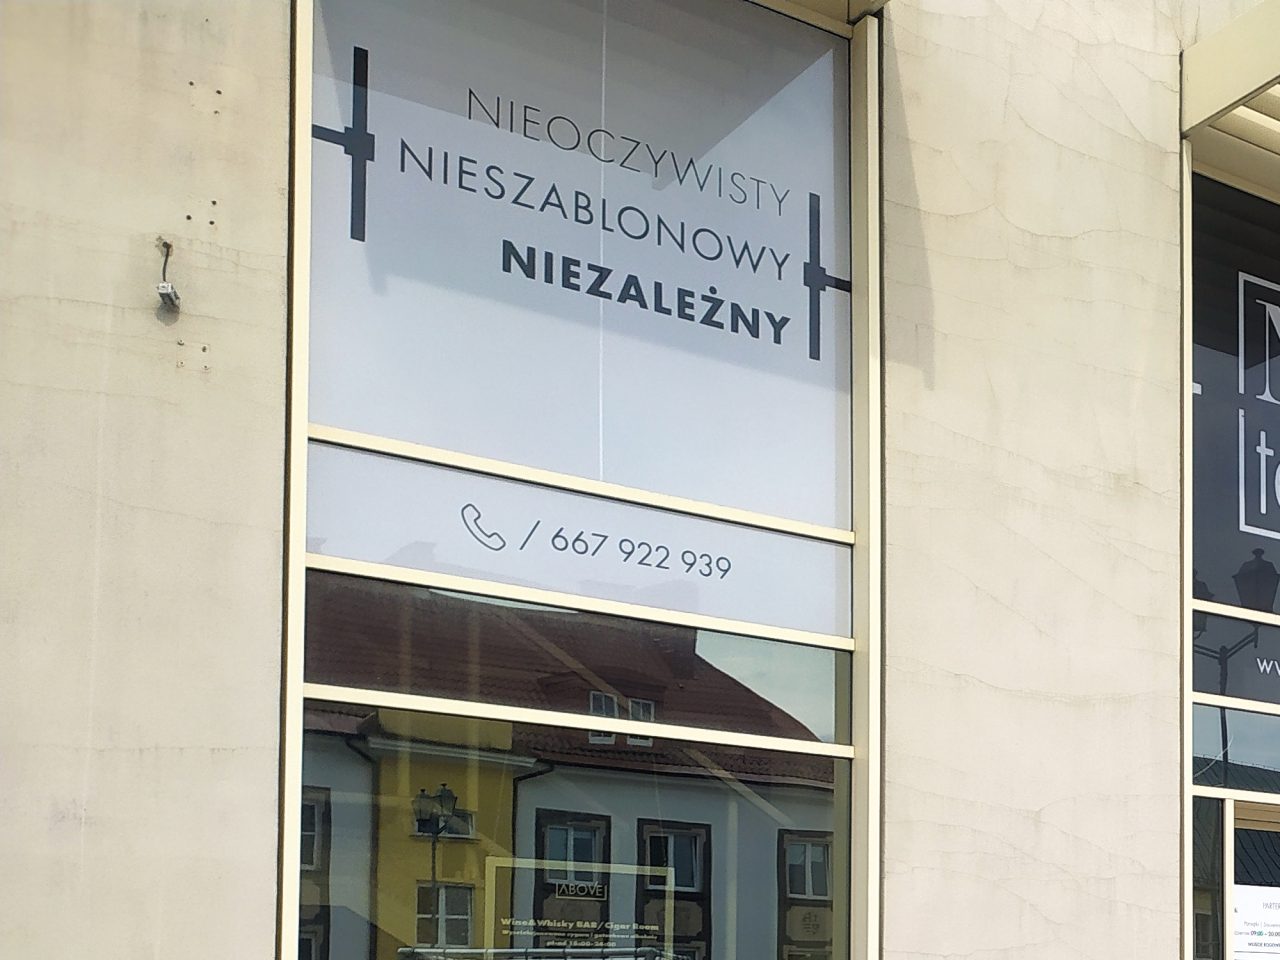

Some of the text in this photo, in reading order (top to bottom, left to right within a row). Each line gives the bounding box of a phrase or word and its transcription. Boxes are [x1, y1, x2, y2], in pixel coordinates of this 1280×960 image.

[399, 137, 791, 281] NIESZABLONOWY
[468, 87, 791, 217] NIEOCZYWISTY
[502, 238, 792, 346] NIEZALEŻNY
[550, 526, 610, 557] 667
[618, 537, 671, 570] 922
[681, 549, 733, 580] 939
